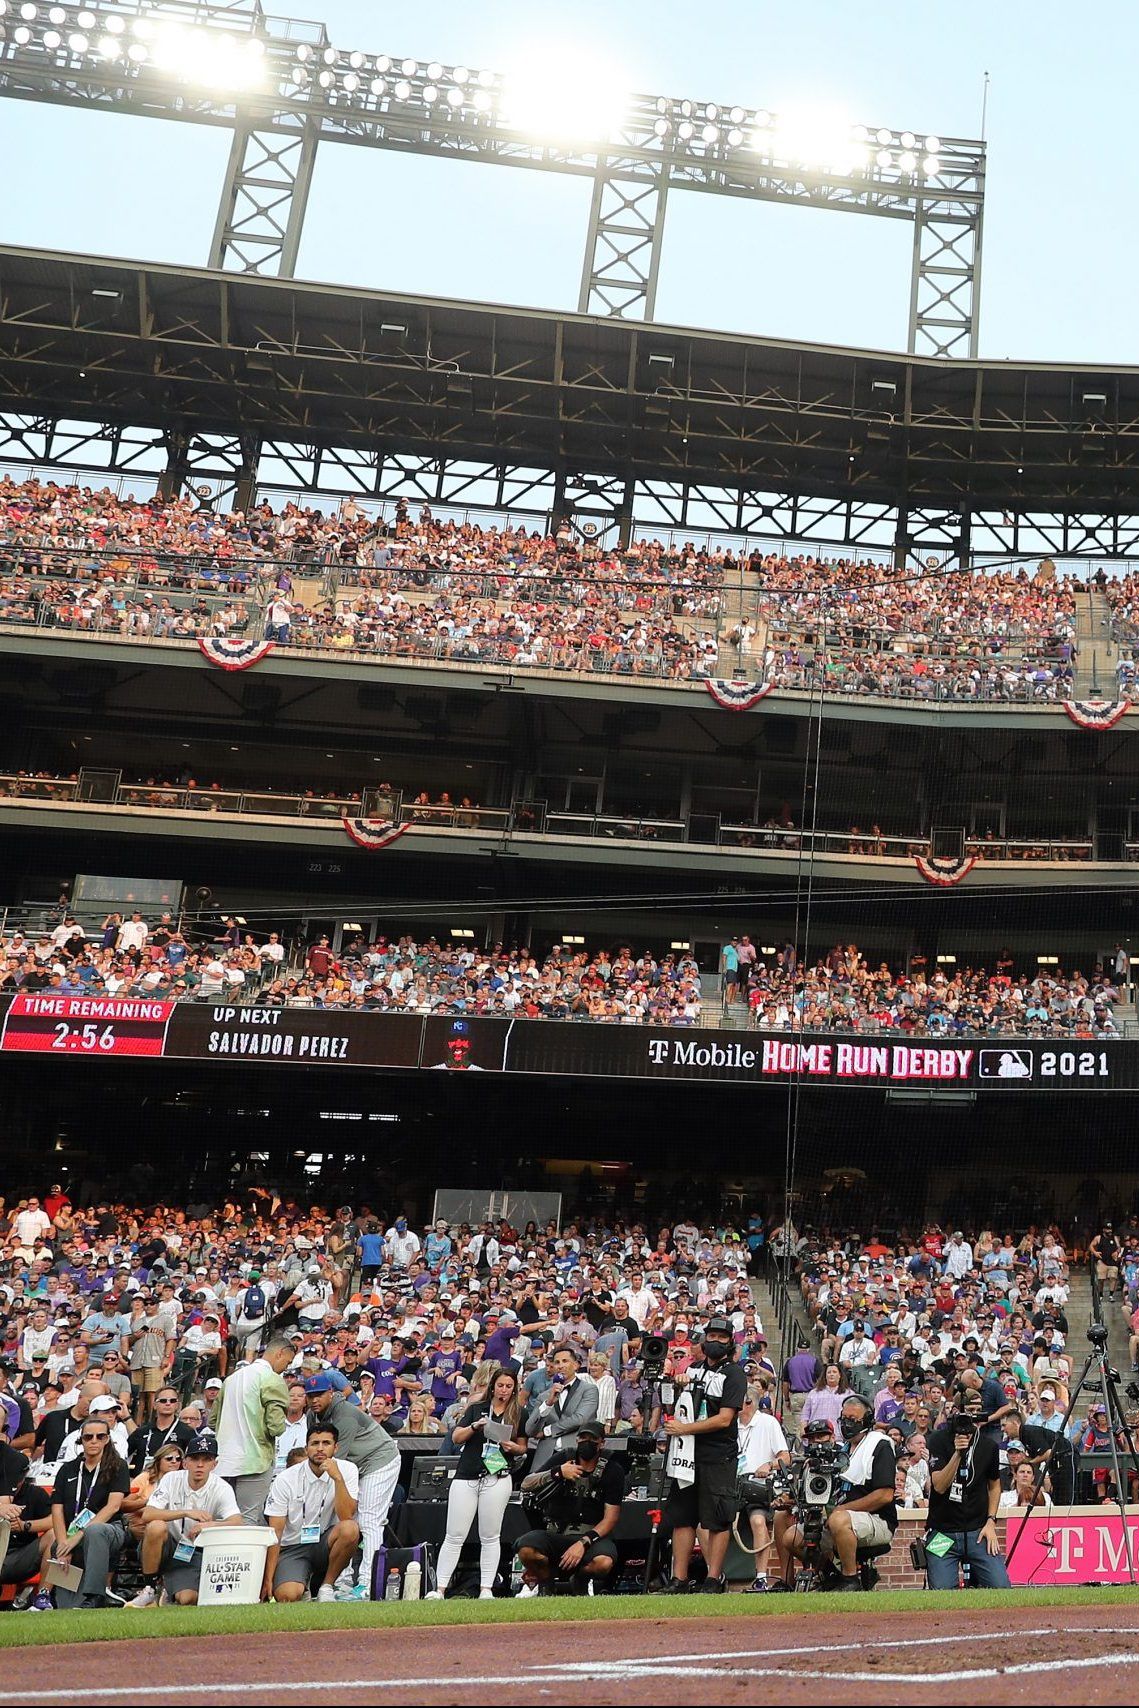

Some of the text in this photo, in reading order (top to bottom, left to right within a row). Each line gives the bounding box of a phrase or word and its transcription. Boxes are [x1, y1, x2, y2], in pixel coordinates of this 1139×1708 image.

[25, 998, 164, 1019] TIME REMAINING
[213, 1007, 282, 1025] UP NEXT
[52, 1022, 116, 1050] 2:56
[208, 1031, 350, 1059] SALVADOR PEREZ
[673, 1041, 756, 1068] Mobile
[762, 1040, 832, 1075] HOME
[836, 1043, 889, 1078] RUN
[891, 1045, 974, 1079] DERBY
[1040, 1052, 1109, 1076] 2021
[210, 1573, 241, 1583] GAME
